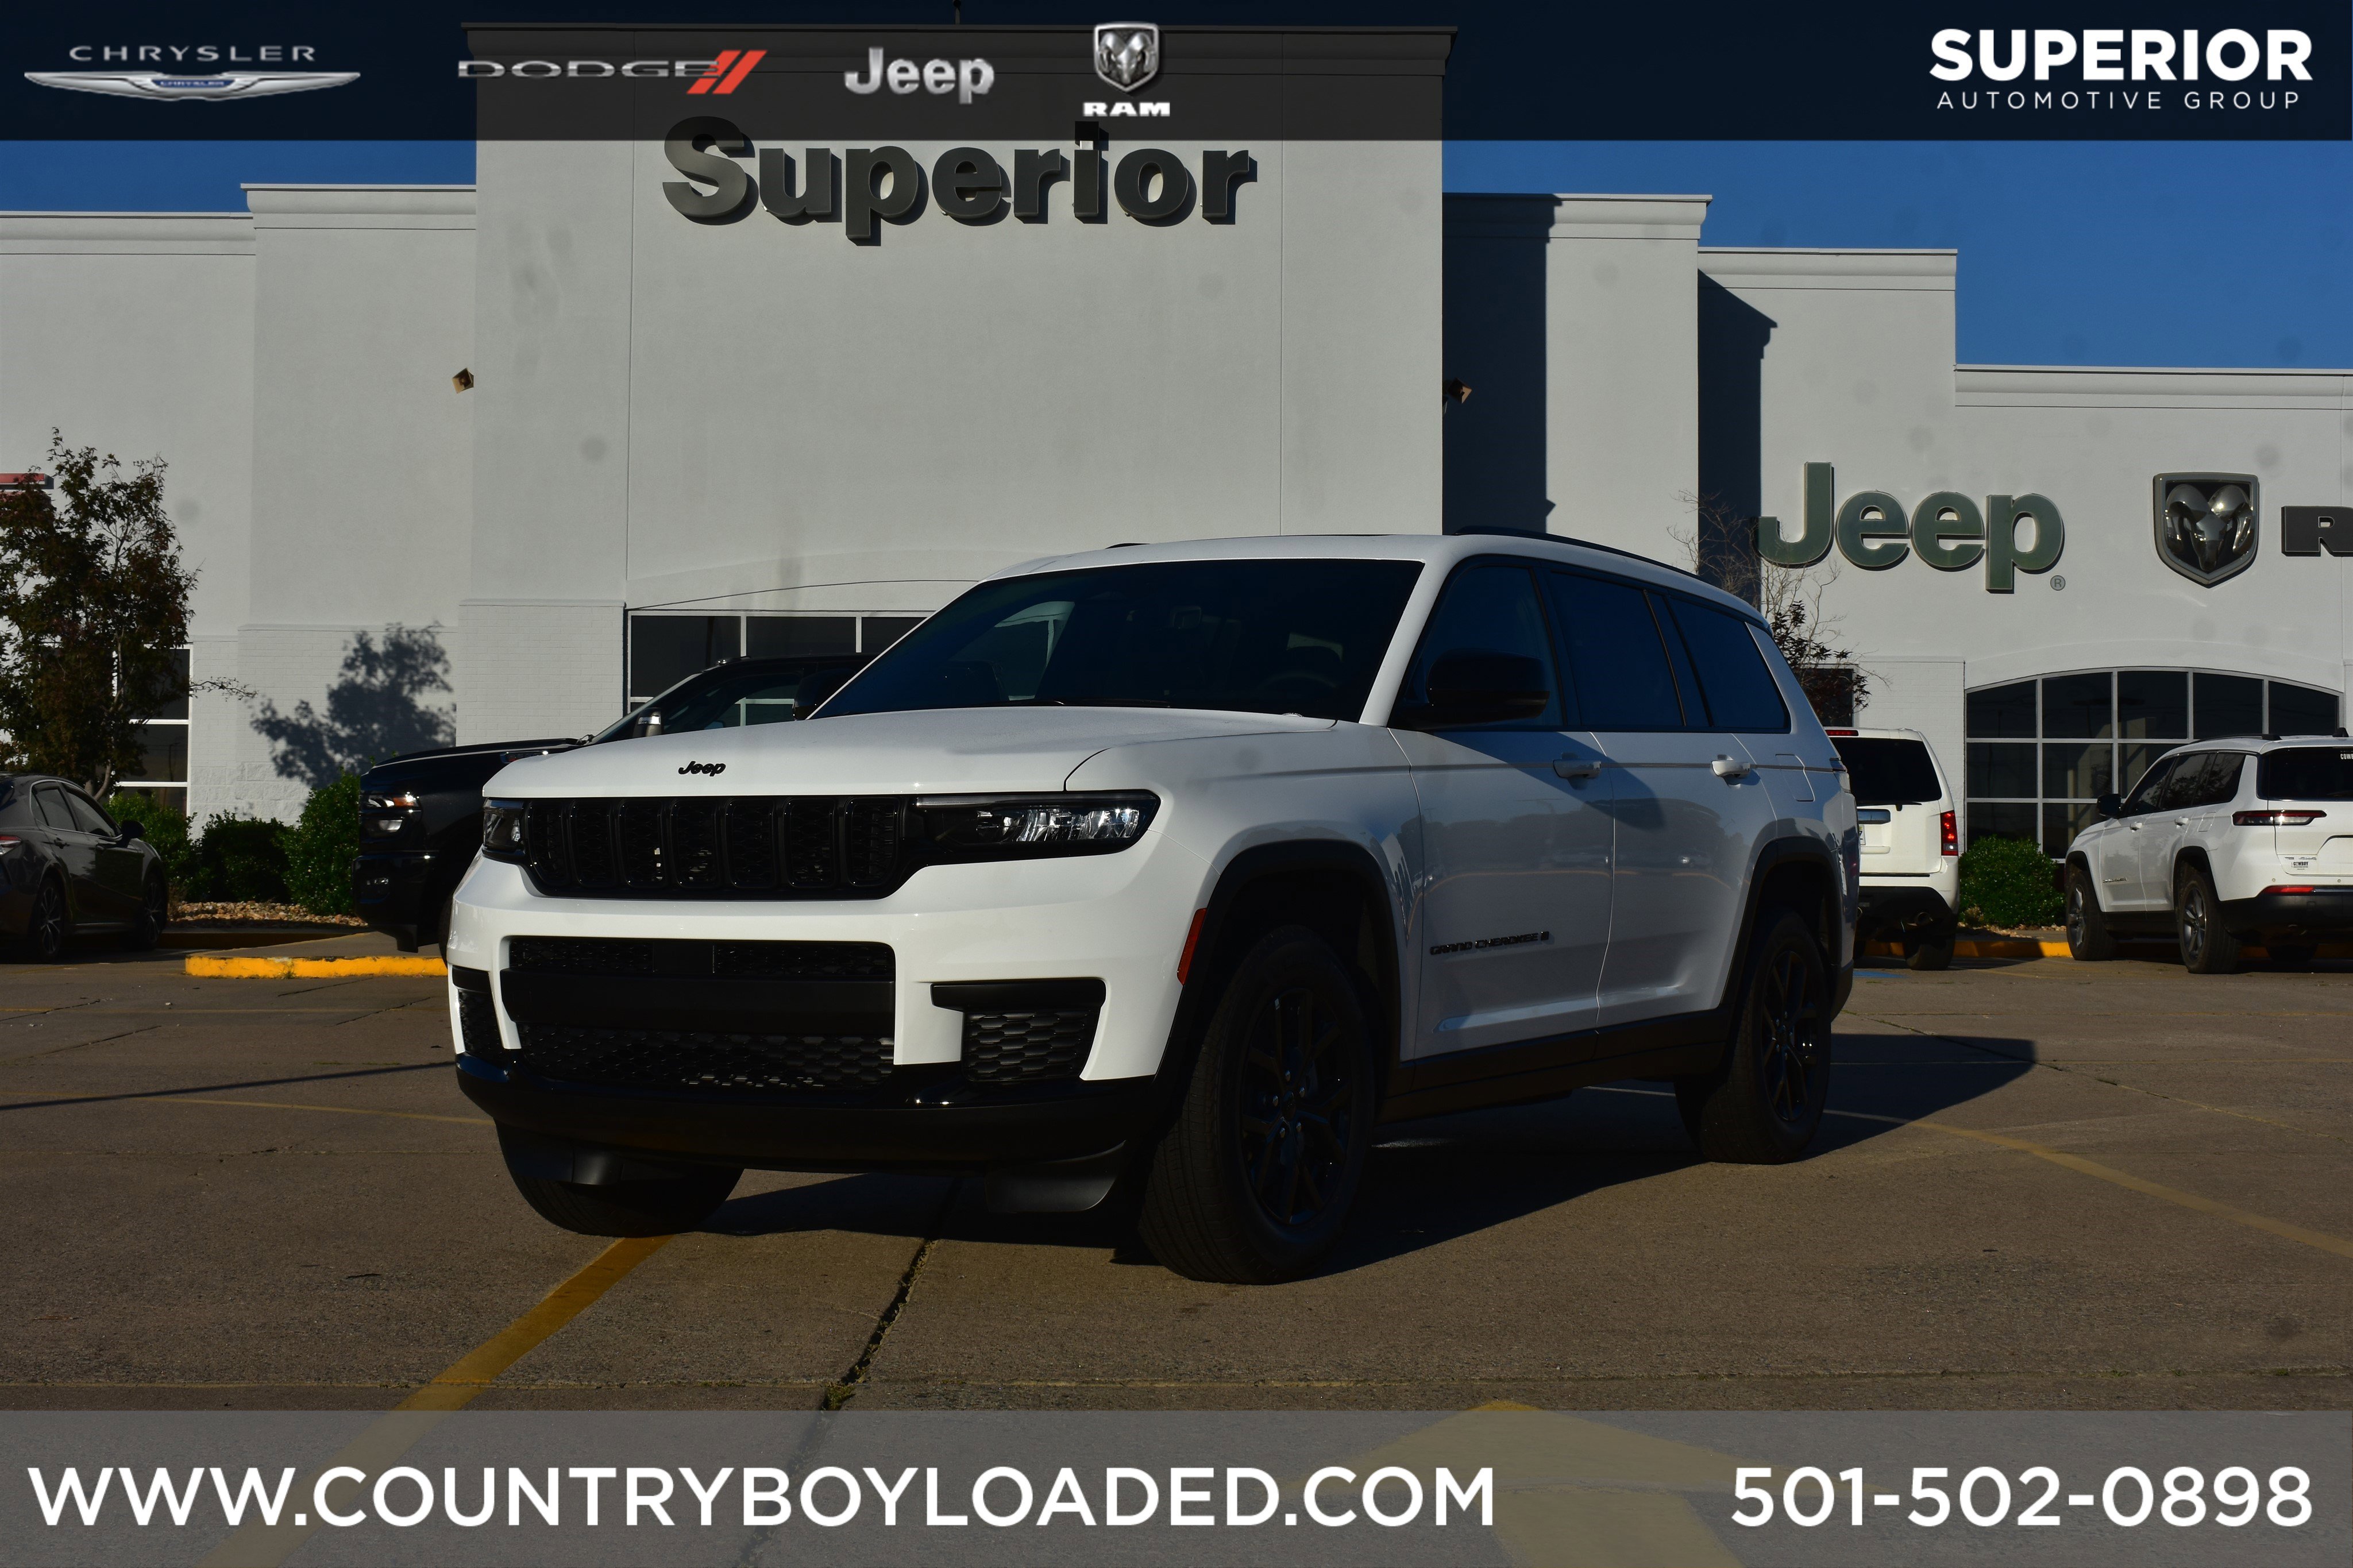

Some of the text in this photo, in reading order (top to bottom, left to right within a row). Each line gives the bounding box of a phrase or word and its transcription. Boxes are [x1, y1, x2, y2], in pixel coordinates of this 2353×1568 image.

[662, 116, 1251, 239] Superior
[1757, 461, 2063, 592] Jeep
[678, 760, 726, 777] Jeep
[1430, 941, 1472, 956] GRAND
[1474, 933, 1538, 949] CHEROKEE
